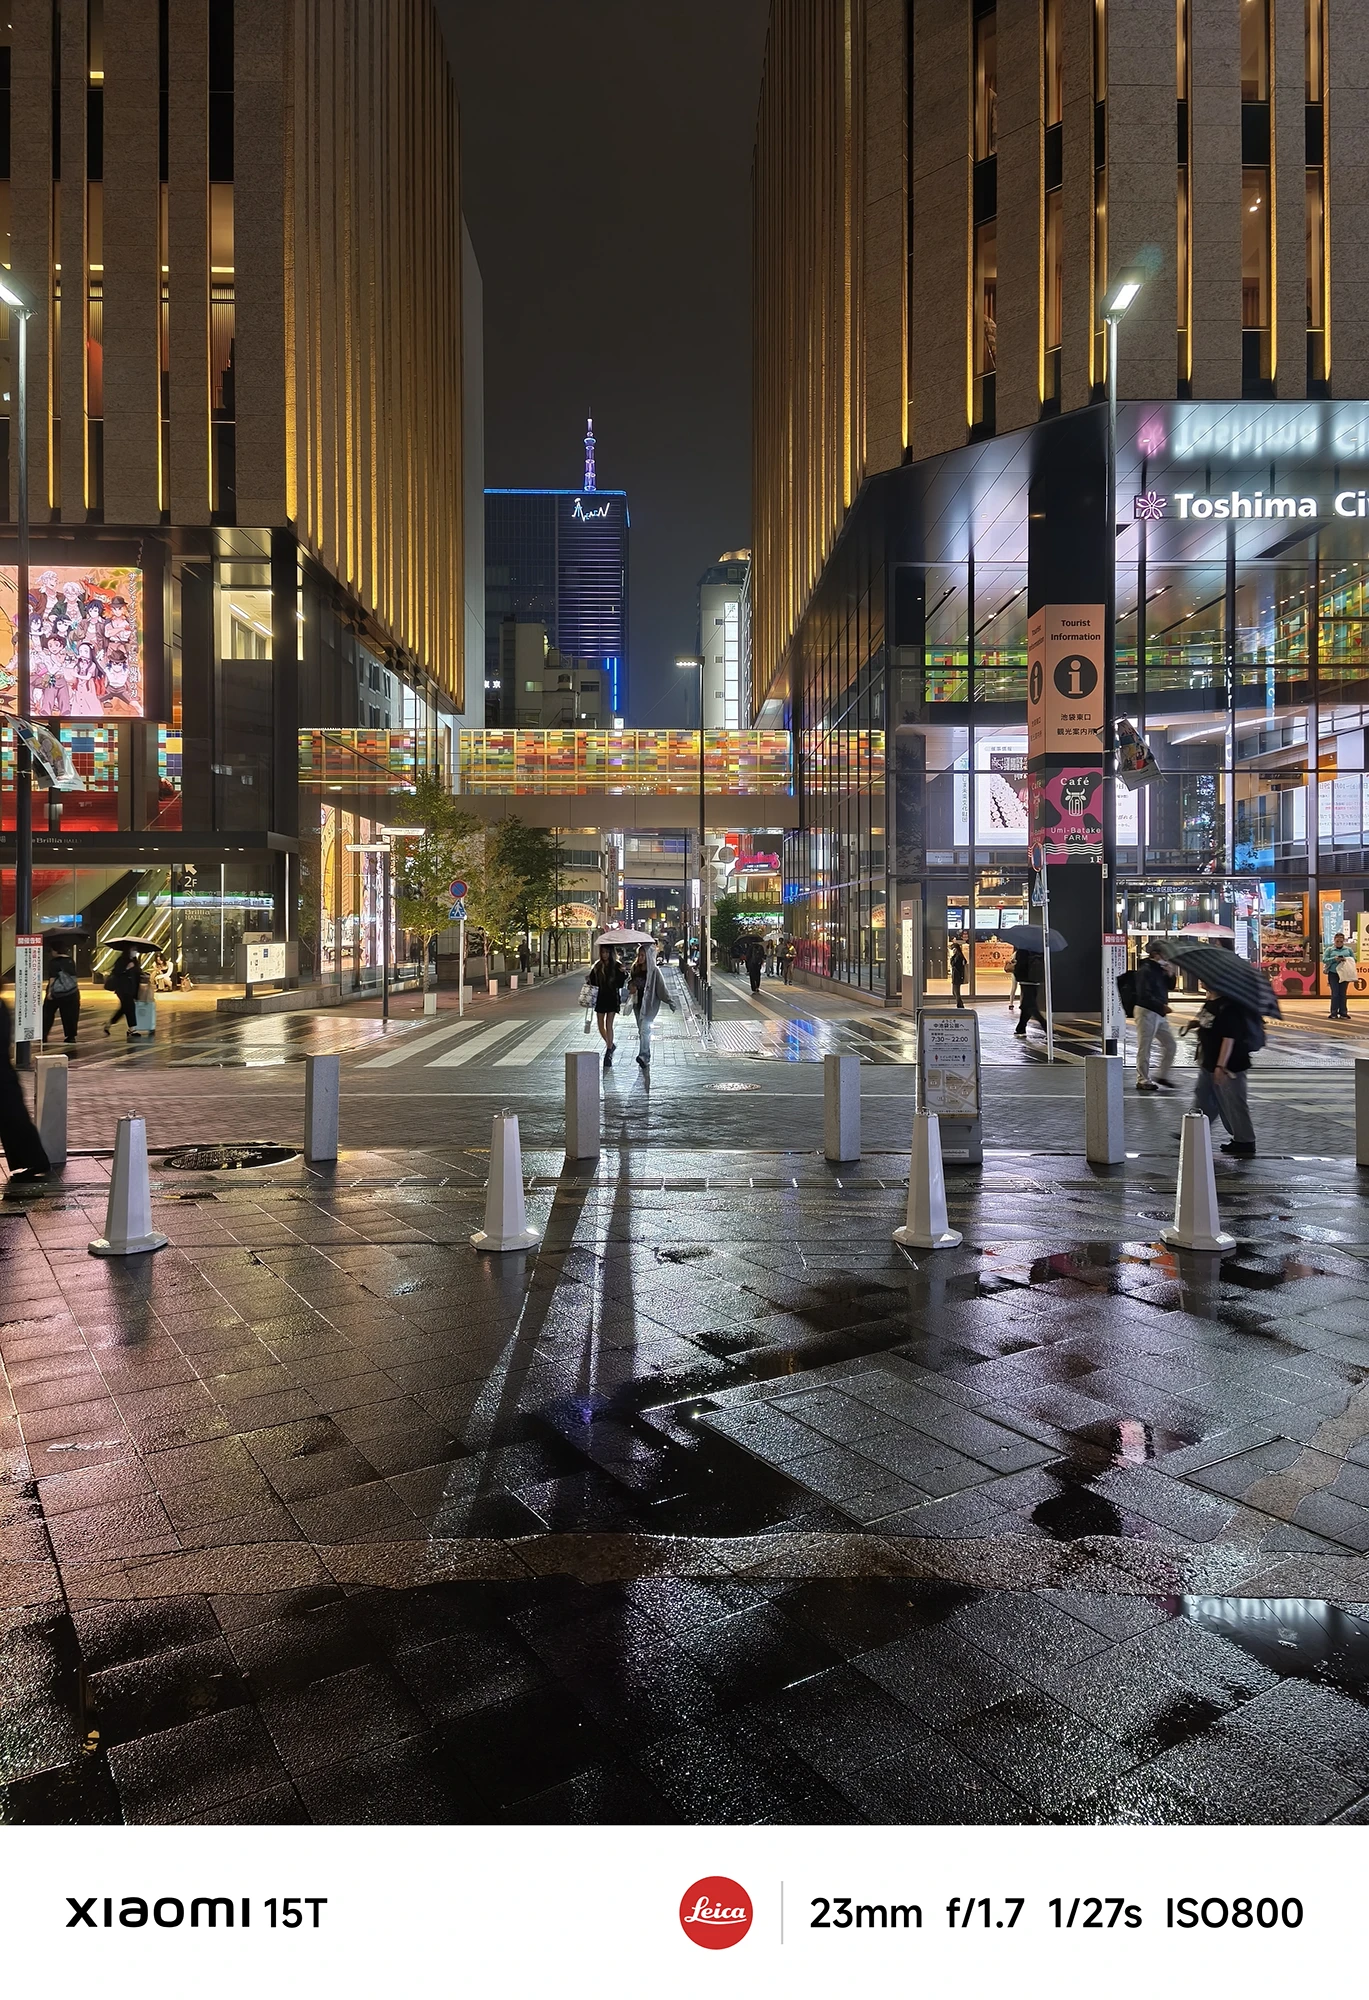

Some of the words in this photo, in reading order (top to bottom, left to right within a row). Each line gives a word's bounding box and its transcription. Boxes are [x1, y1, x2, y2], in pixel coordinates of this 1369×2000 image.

[1174, 491, 1316, 519] Toshima
[1334, 491, 1369, 519] Ci
[1061, 619, 1090, 627] Tourist
[1051, 633, 1101, 641] Information
[1061, 713, 1091, 721] 池袋東口
[1057, 728, 1097, 736] 観光案内所
[1060, 776, 1090, 786] Café
[184, 876, 198, 887] 2F
